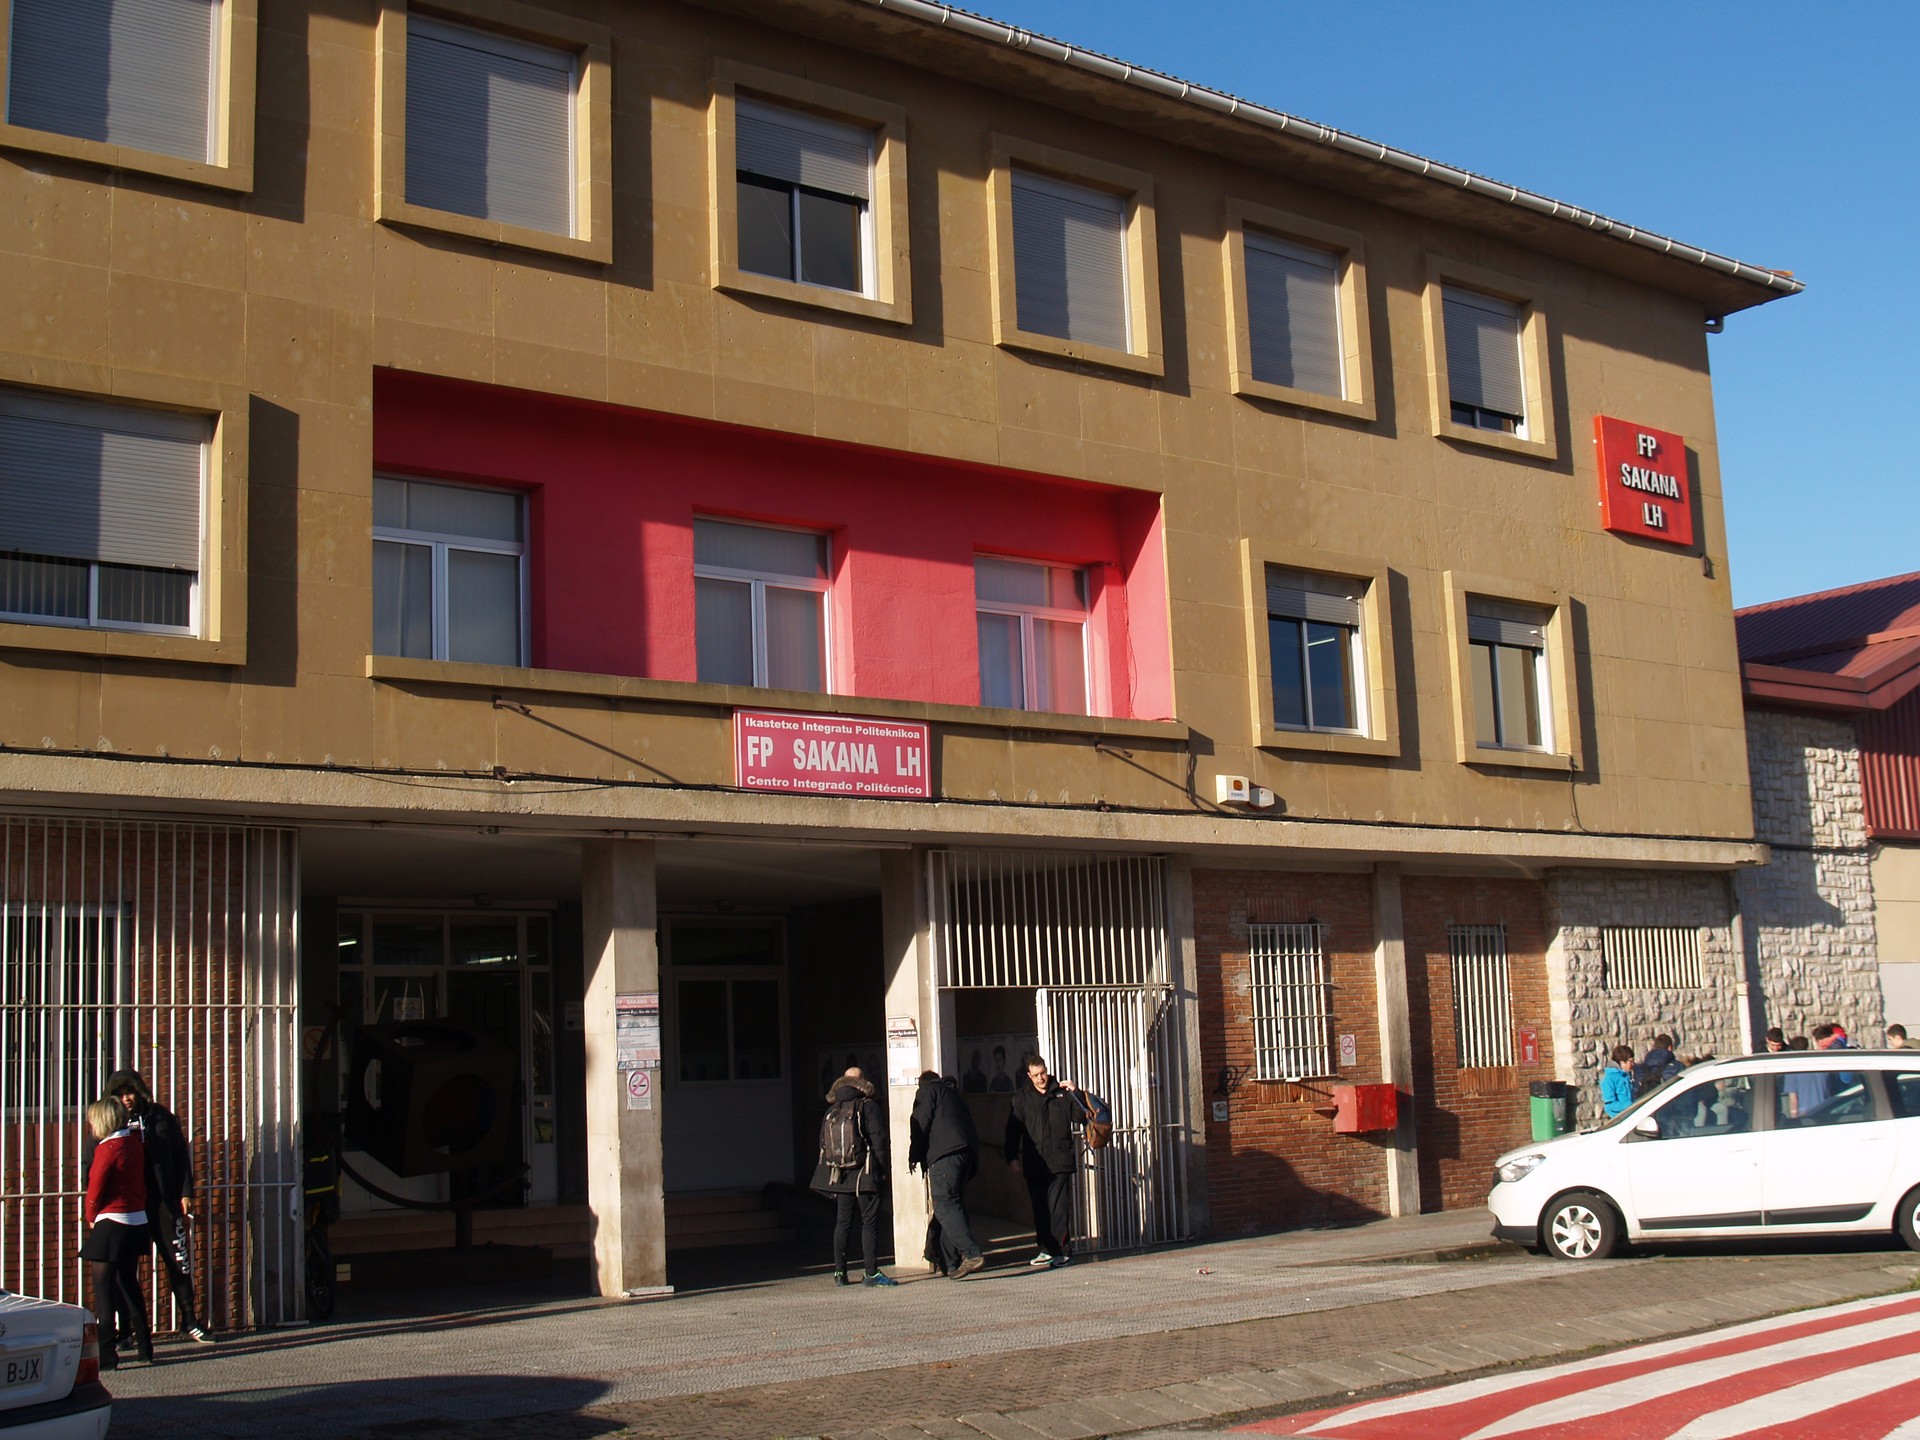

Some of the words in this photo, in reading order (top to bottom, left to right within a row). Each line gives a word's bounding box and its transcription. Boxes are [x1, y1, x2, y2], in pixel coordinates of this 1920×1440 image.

[1638, 433, 1656, 457] FP
[1621, 463, 1679, 498] SAKANA
[1643, 502, 1663, 528] LH
[745, 717, 799, 730] Ikastetxe
[802, 721, 853, 734] Integratu
[855, 726, 920, 739] Politeknikoa
[747, 735, 774, 768] FP
[793, 738, 879, 774] SAKANA
[896, 746, 921, 777] LH
[747, 775, 790, 787] Centro
[793, 778, 853, 791] Integrado
[856, 781, 922, 795] Politécnico
[172, 1217, 190, 1274] adidas
